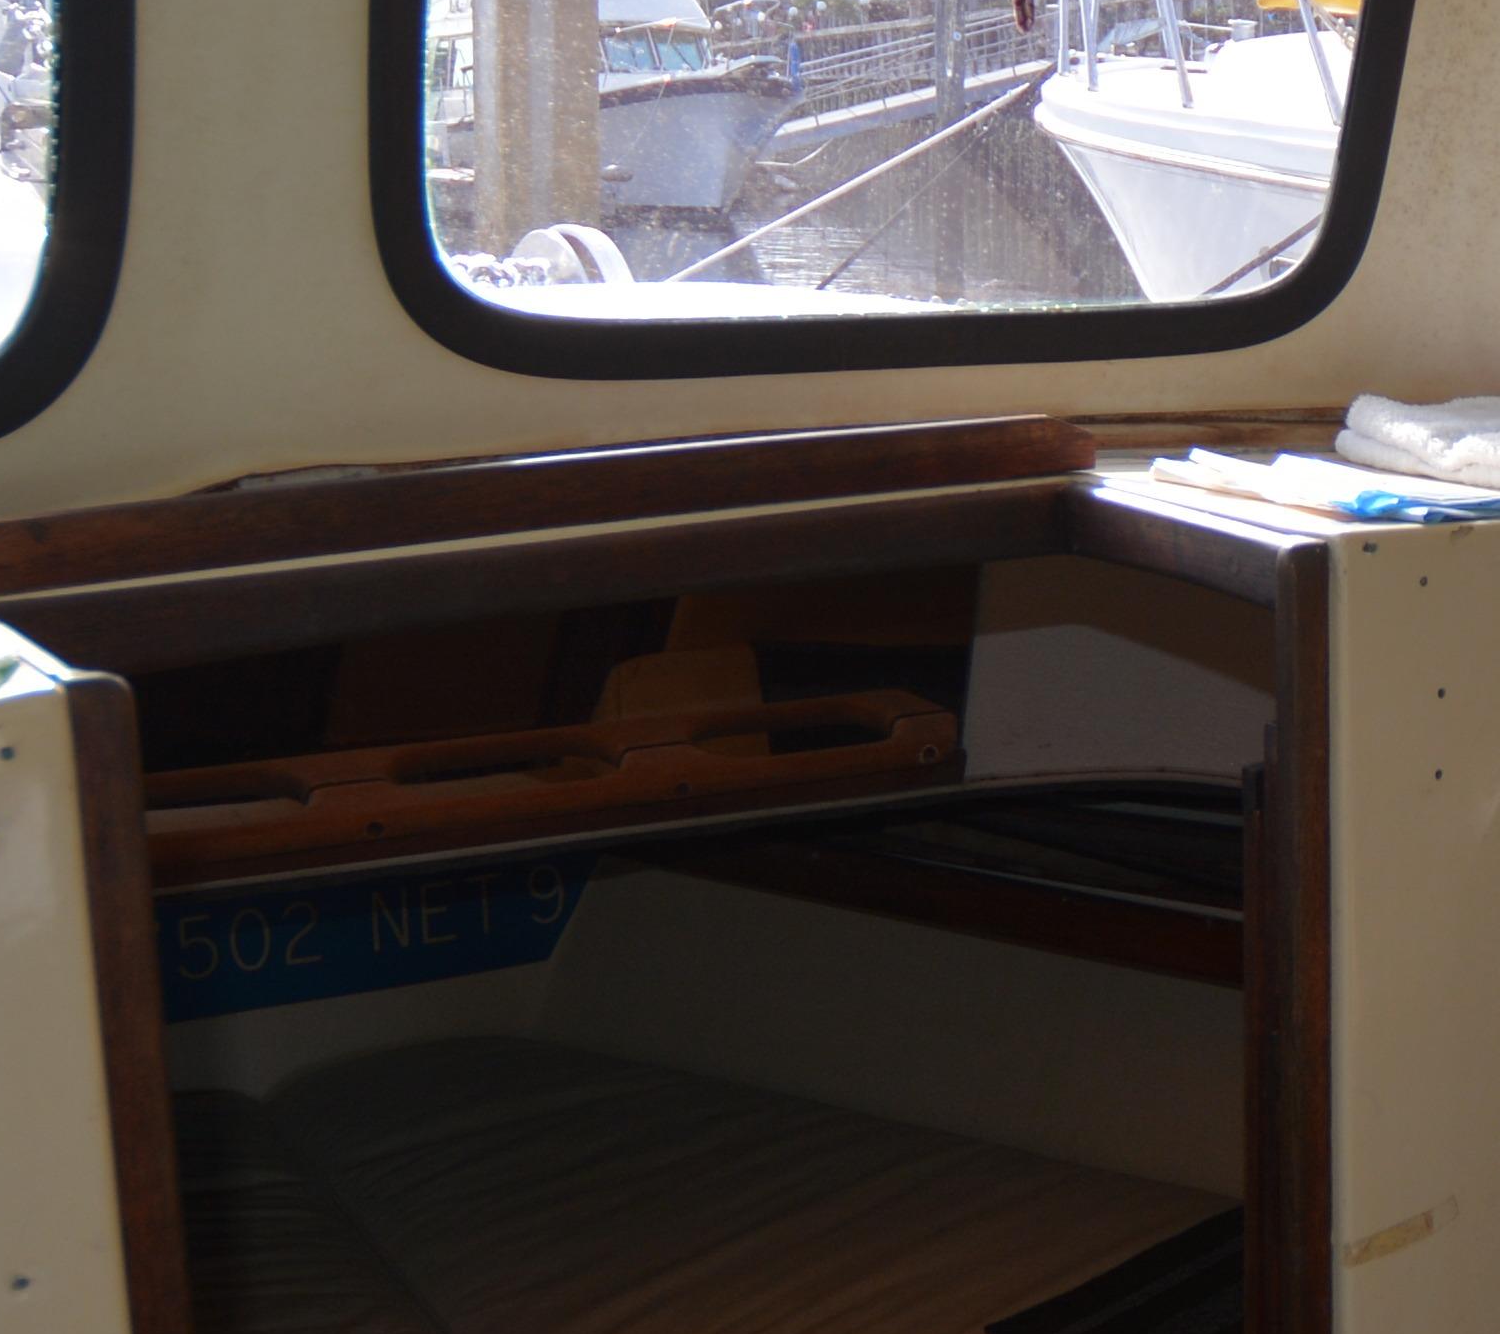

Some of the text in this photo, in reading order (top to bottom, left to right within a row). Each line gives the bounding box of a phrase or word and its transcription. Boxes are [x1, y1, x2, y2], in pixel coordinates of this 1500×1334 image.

[155, 865, 566, 980] 502 NET 9
